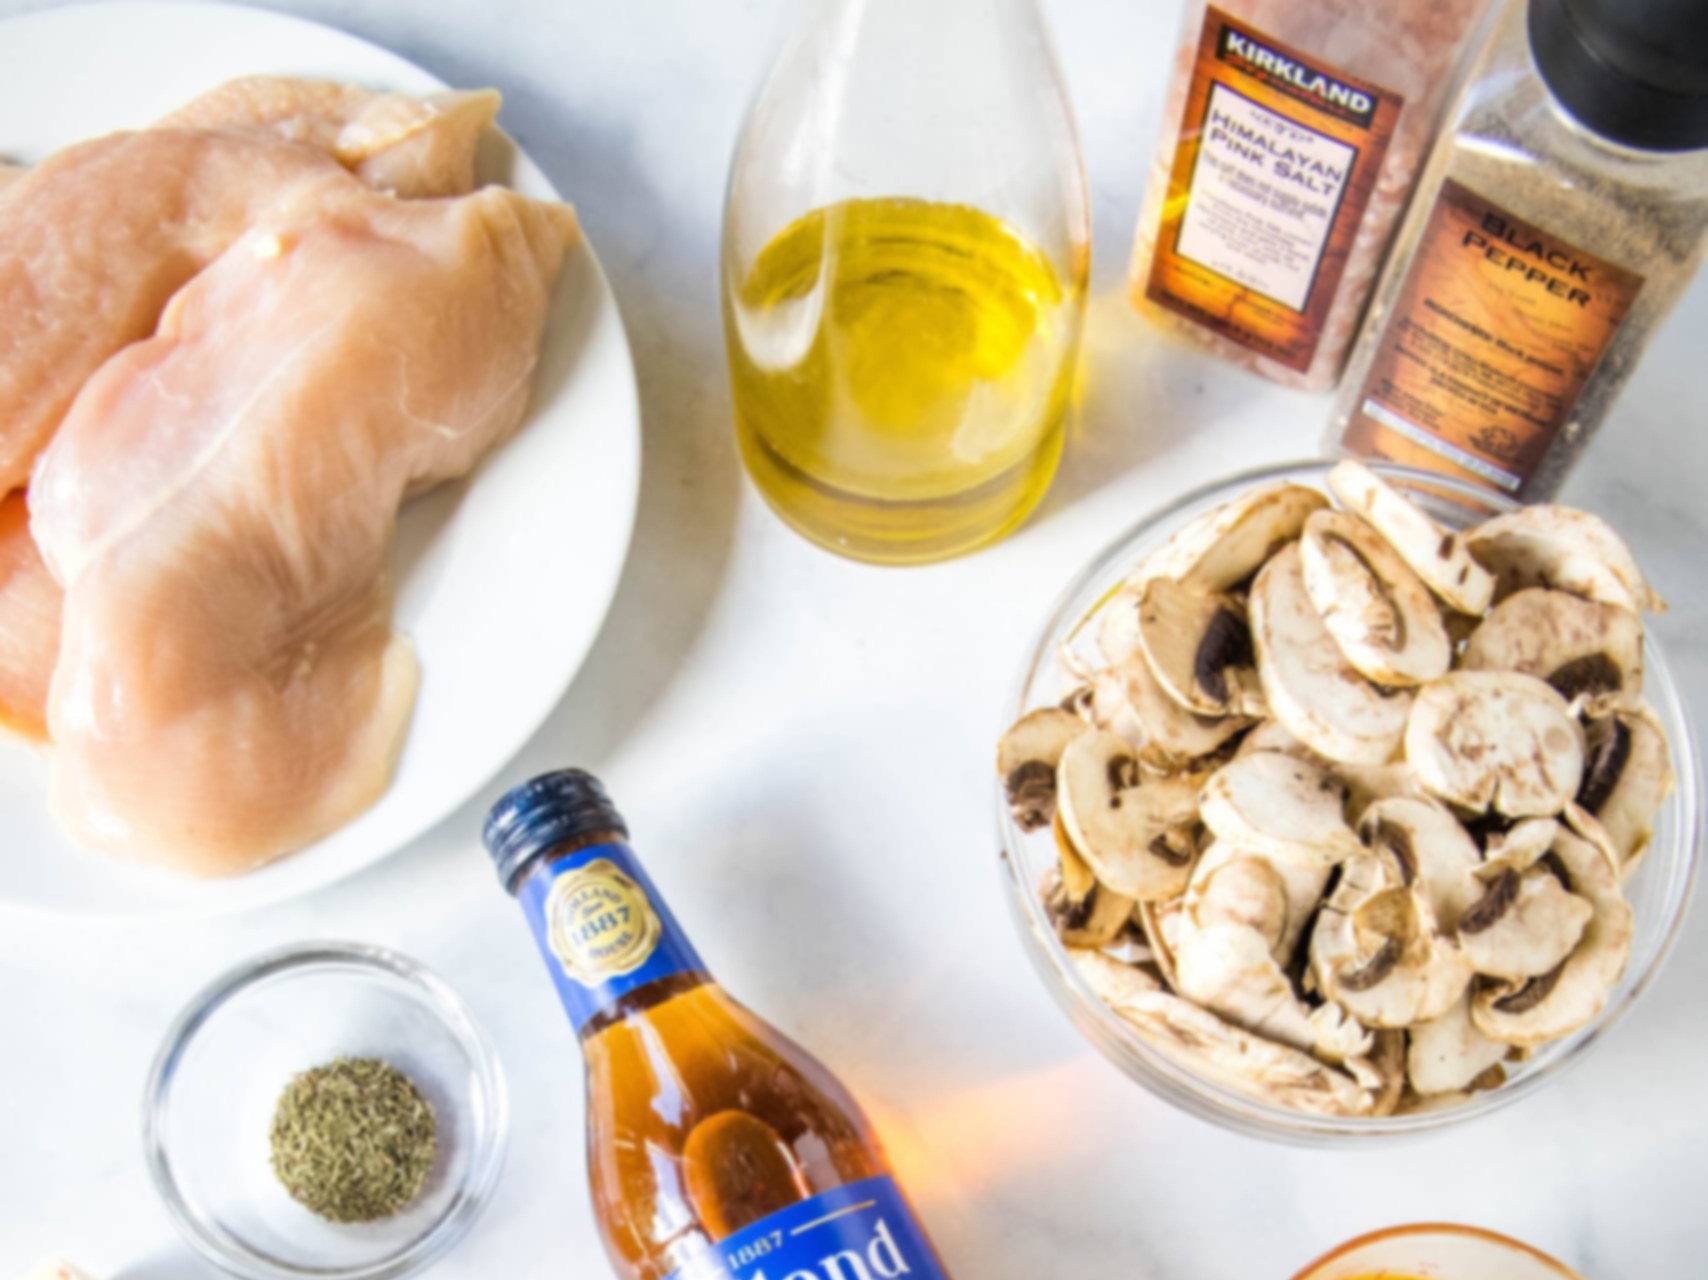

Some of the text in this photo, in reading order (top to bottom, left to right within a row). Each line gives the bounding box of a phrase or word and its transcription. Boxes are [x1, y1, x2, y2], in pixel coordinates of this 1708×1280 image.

[1226, 31, 1372, 114] KIRKLAND
[1209, 128, 1264, 167] PINK
[1273, 161, 1336, 197] SALT
[1210, 109, 1343, 183] HIMALAYAN
[1462, 230, 1591, 308] PEPPER
[1482, 211, 1594, 283] BLACK
[727, 1229, 784, 1270] 1887
